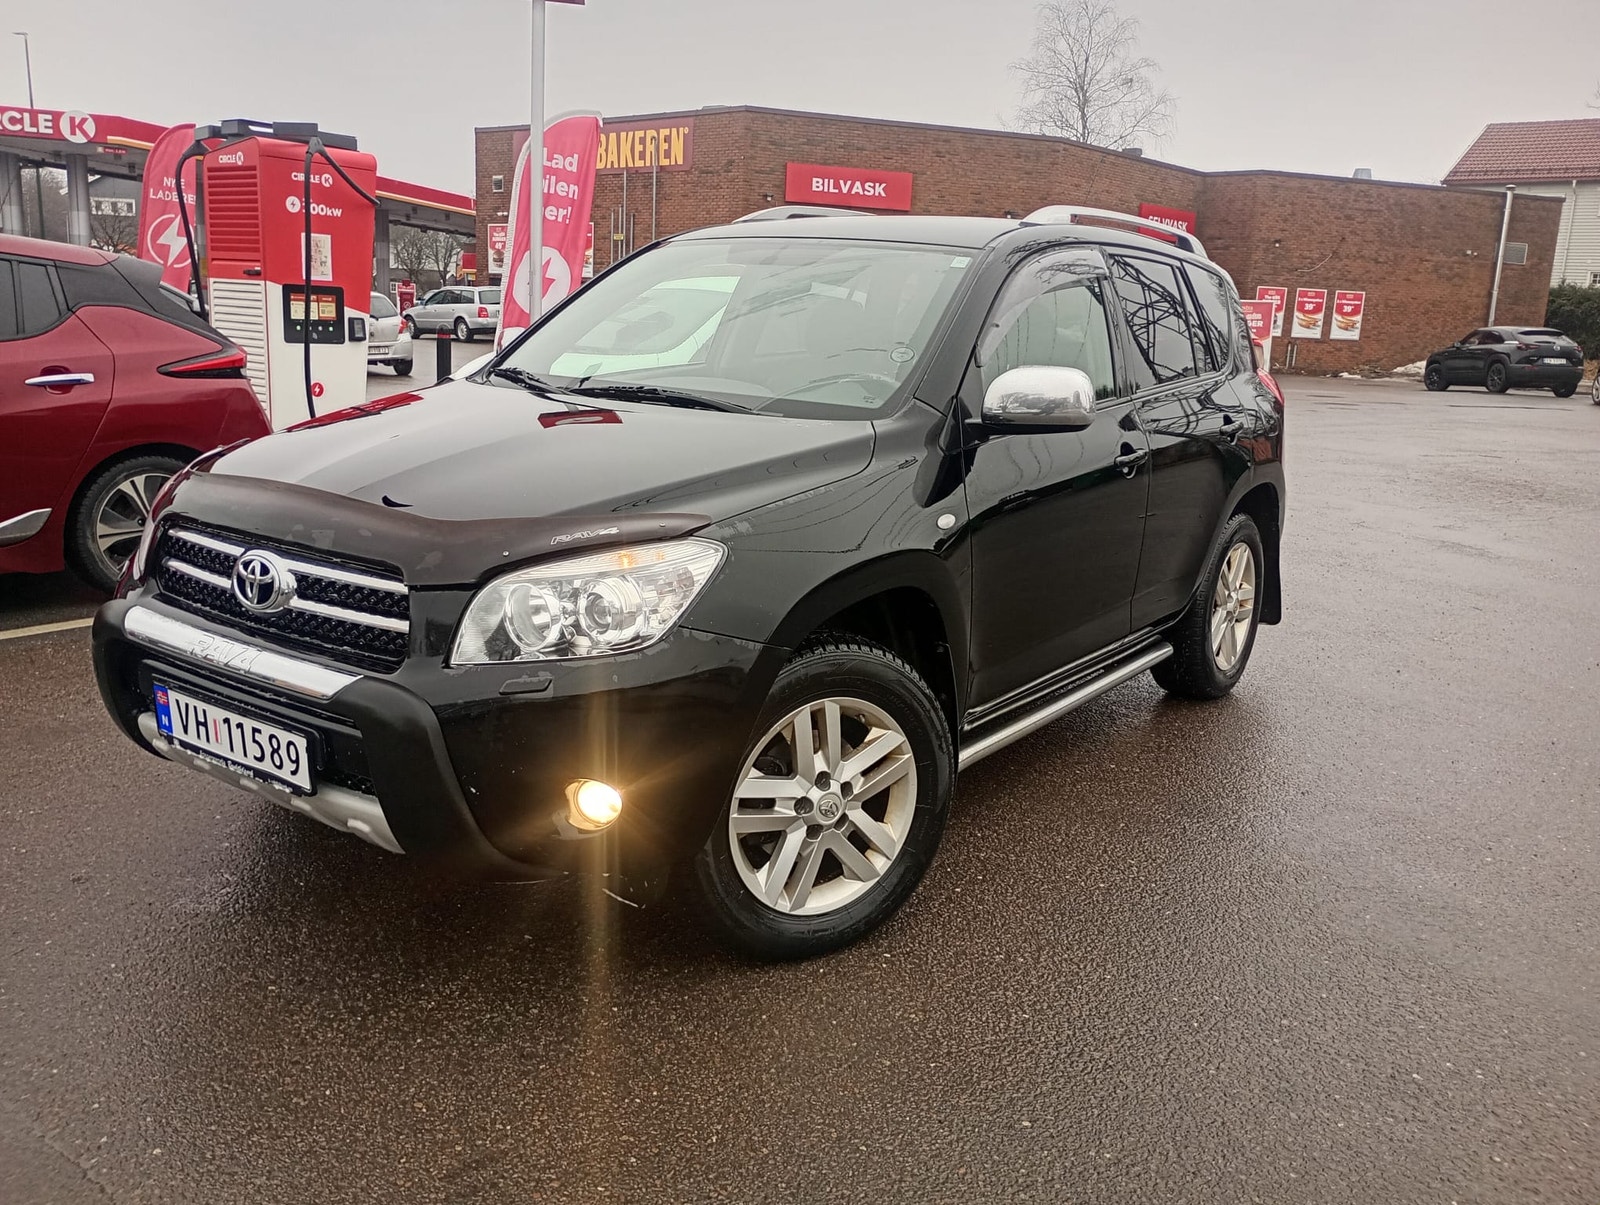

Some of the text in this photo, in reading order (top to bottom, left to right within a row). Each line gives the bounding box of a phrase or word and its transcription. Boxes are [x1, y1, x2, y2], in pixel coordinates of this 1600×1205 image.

[0, 110, 54, 135] CLE
[291, 172, 320, 184] CIRLE
[543, 175, 579, 200] ilen
[812, 177, 887, 197] BILVASK
[543, 204, 573, 224] er!
[551, 527, 620, 545] RAV4
[175, 698, 211, 745] VH
[222, 716, 301, 777] 11589
